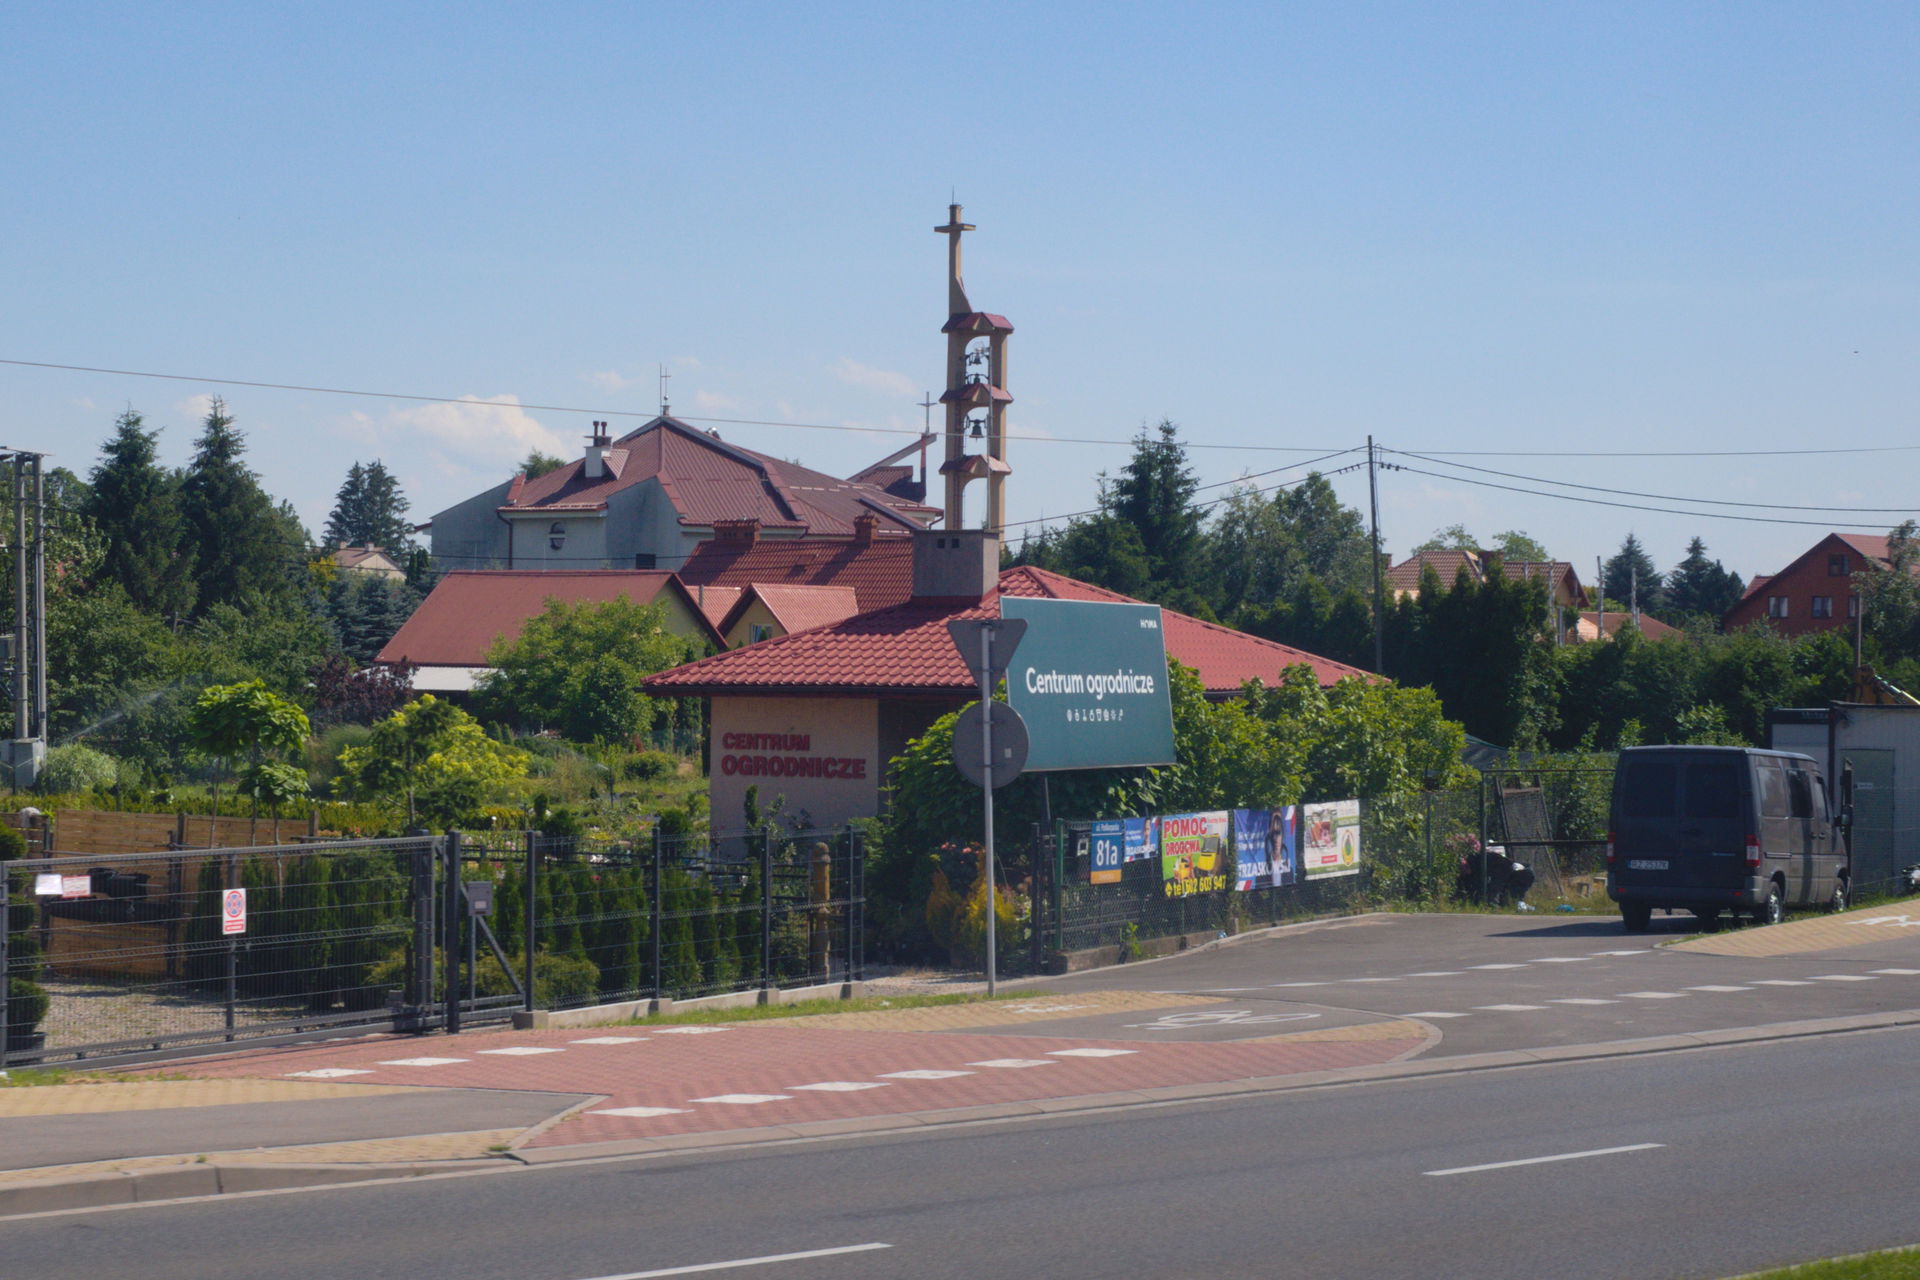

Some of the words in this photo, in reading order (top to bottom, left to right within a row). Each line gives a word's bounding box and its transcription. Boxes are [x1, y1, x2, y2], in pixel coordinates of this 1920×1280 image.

[1026, 667, 1084, 694] Centrum
[1086, 668, 1154, 700] ogrodnicze
[721, 732, 810, 751] CENTRUM
[721, 754, 866, 779] OGRODNICZE
[1163, 817, 1207, 839] POMOC
[1096, 839, 1118, 866] 81a
[1165, 840, 1201, 856] DROGOWA
